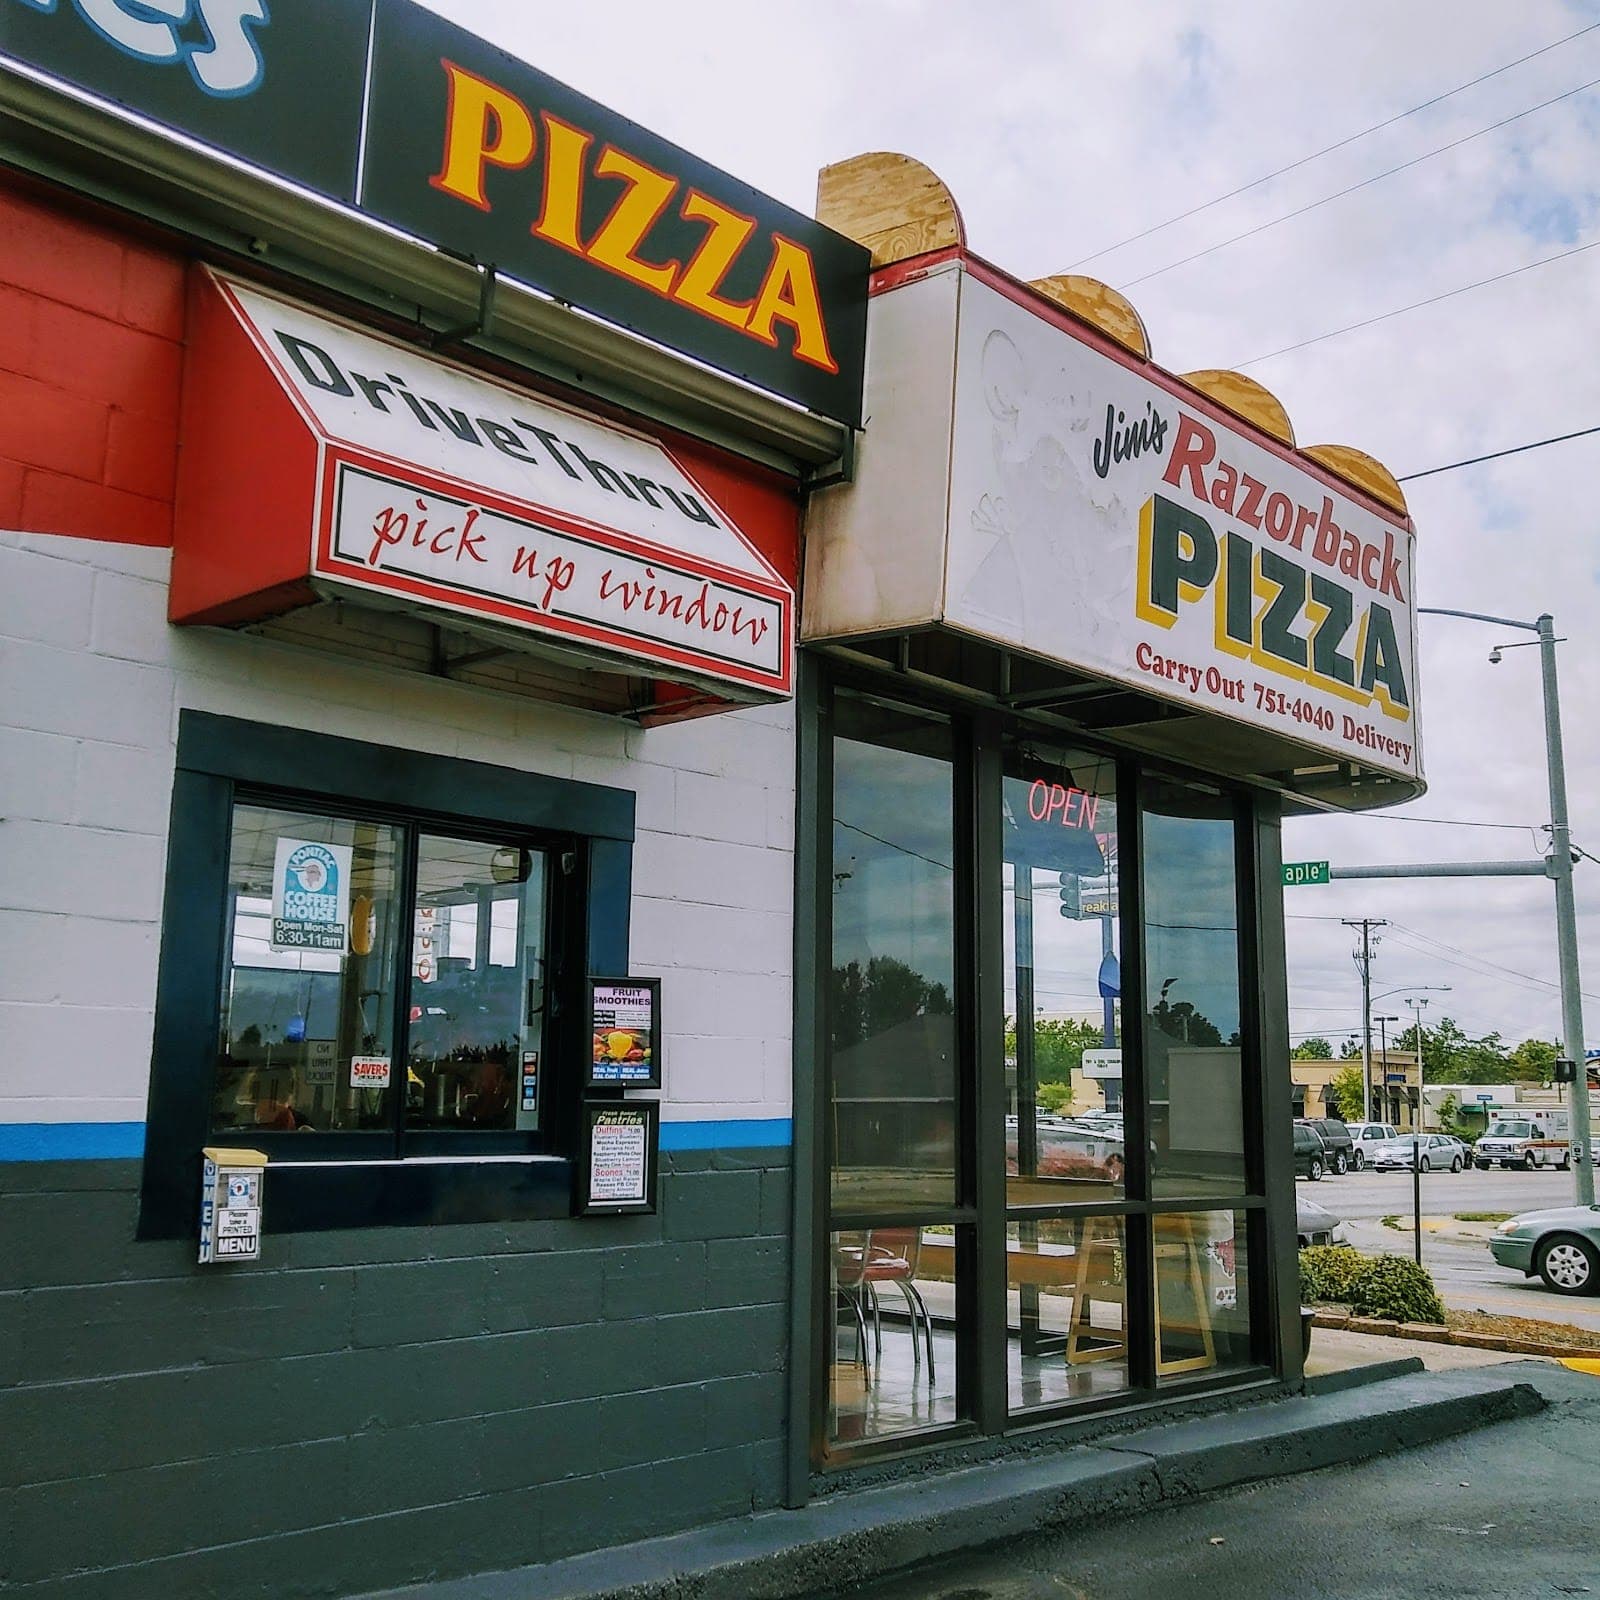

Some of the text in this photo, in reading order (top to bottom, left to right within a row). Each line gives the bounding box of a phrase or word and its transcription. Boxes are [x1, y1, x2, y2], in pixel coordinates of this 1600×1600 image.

[429, 57, 840, 375] PIZZA
[1094, 401, 1168, 478] Jim's
[1162, 411, 1407, 603] Razorback
[369, 498, 769, 646] pick up window
[1136, 492, 1410, 722] PIZZA
[1253, 682, 1335, 731] 751-4040
[1342, 714, 1412, 765] Delivery
[1028, 778, 1100, 832] OPEN
[292, 846, 335, 869] PONTIAC
[1285, 863, 1319, 884] aple
[285, 891, 337, 908] COFFEE
[285, 903, 336, 921] HOUSE
[275, 919, 344, 934] Open Mon-Sat
[275, 930, 342, 947] 6:30-11am
[612, 988, 642, 997] FRUIT
[597, 1115, 643, 1125] Pastries
[595, 1168, 623, 1176] Scones
[223, 1225, 253, 1234] PRINTED
[217, 1237, 256, 1254] MENU
